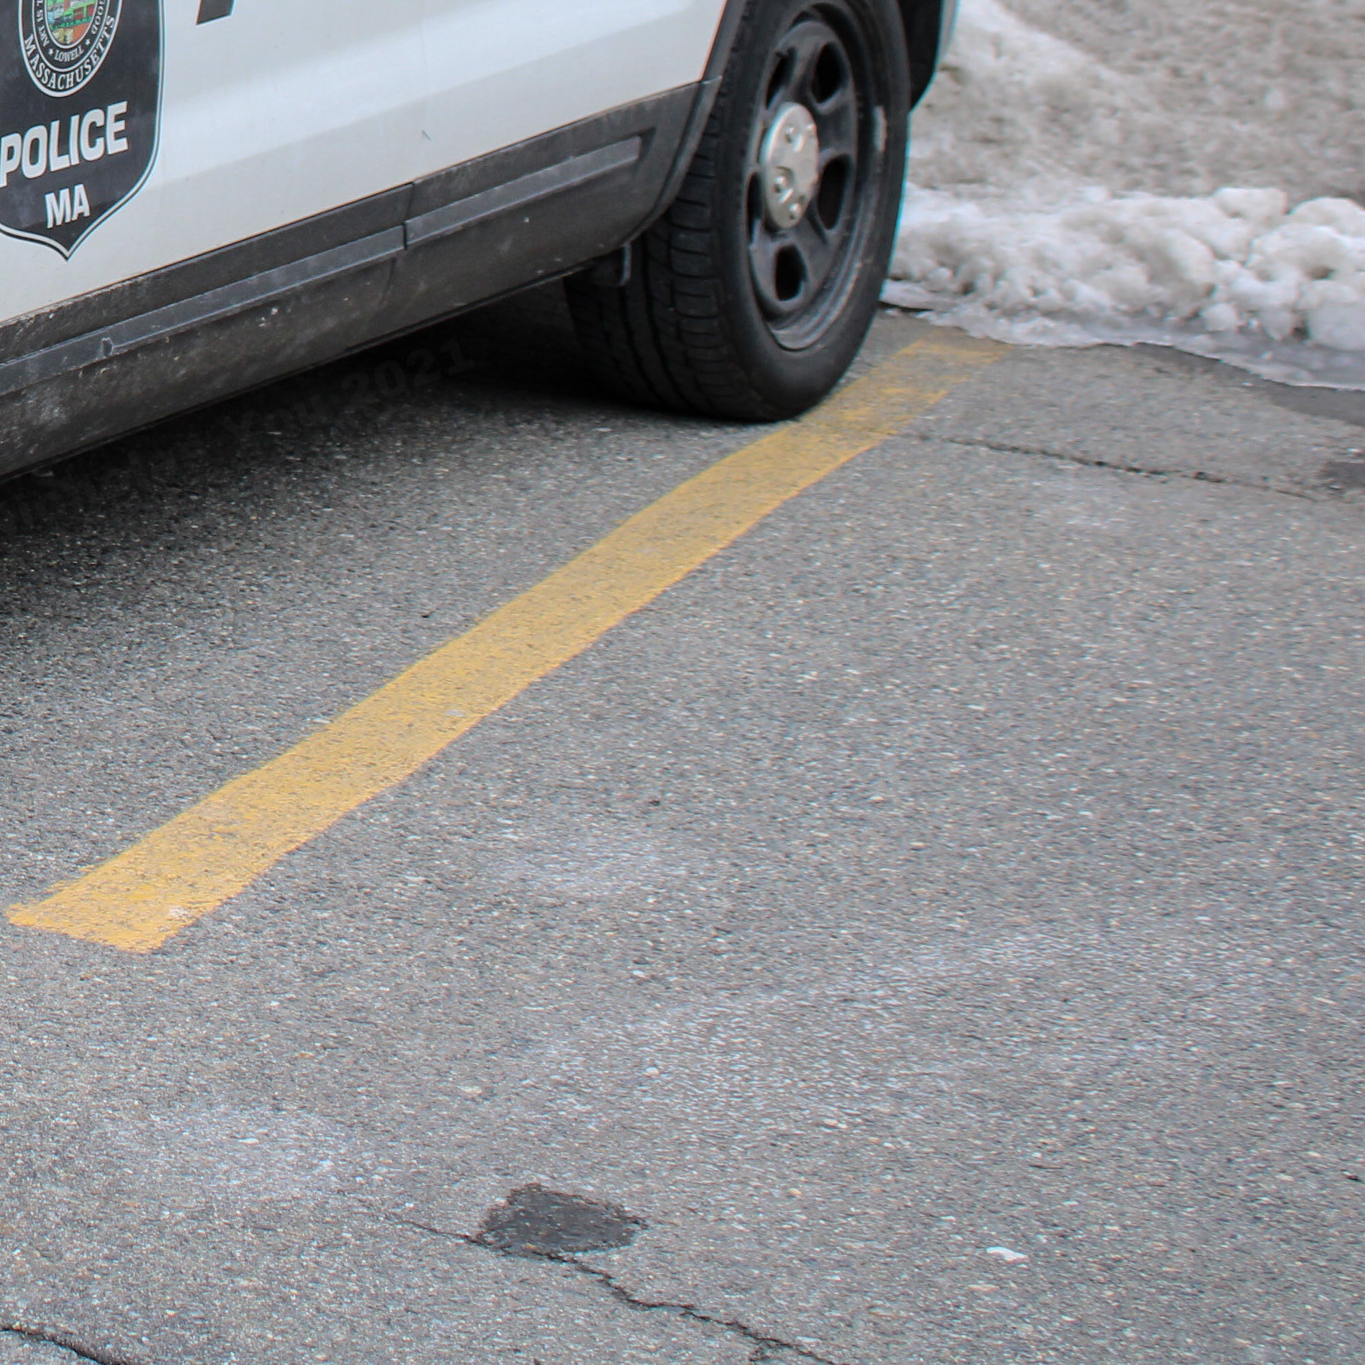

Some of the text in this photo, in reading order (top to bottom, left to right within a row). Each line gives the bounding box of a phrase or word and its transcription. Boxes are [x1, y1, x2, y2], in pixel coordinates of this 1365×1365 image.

[36, 9, 44, 23] IS
[24, 15, 115, 90] MASSACHUSETTS
[38, 25, 50, 47] ART
[54, 44, 84, 62] LOWELL
[0, 101, 129, 188] POLICE
[45, 183, 91, 229] MA
